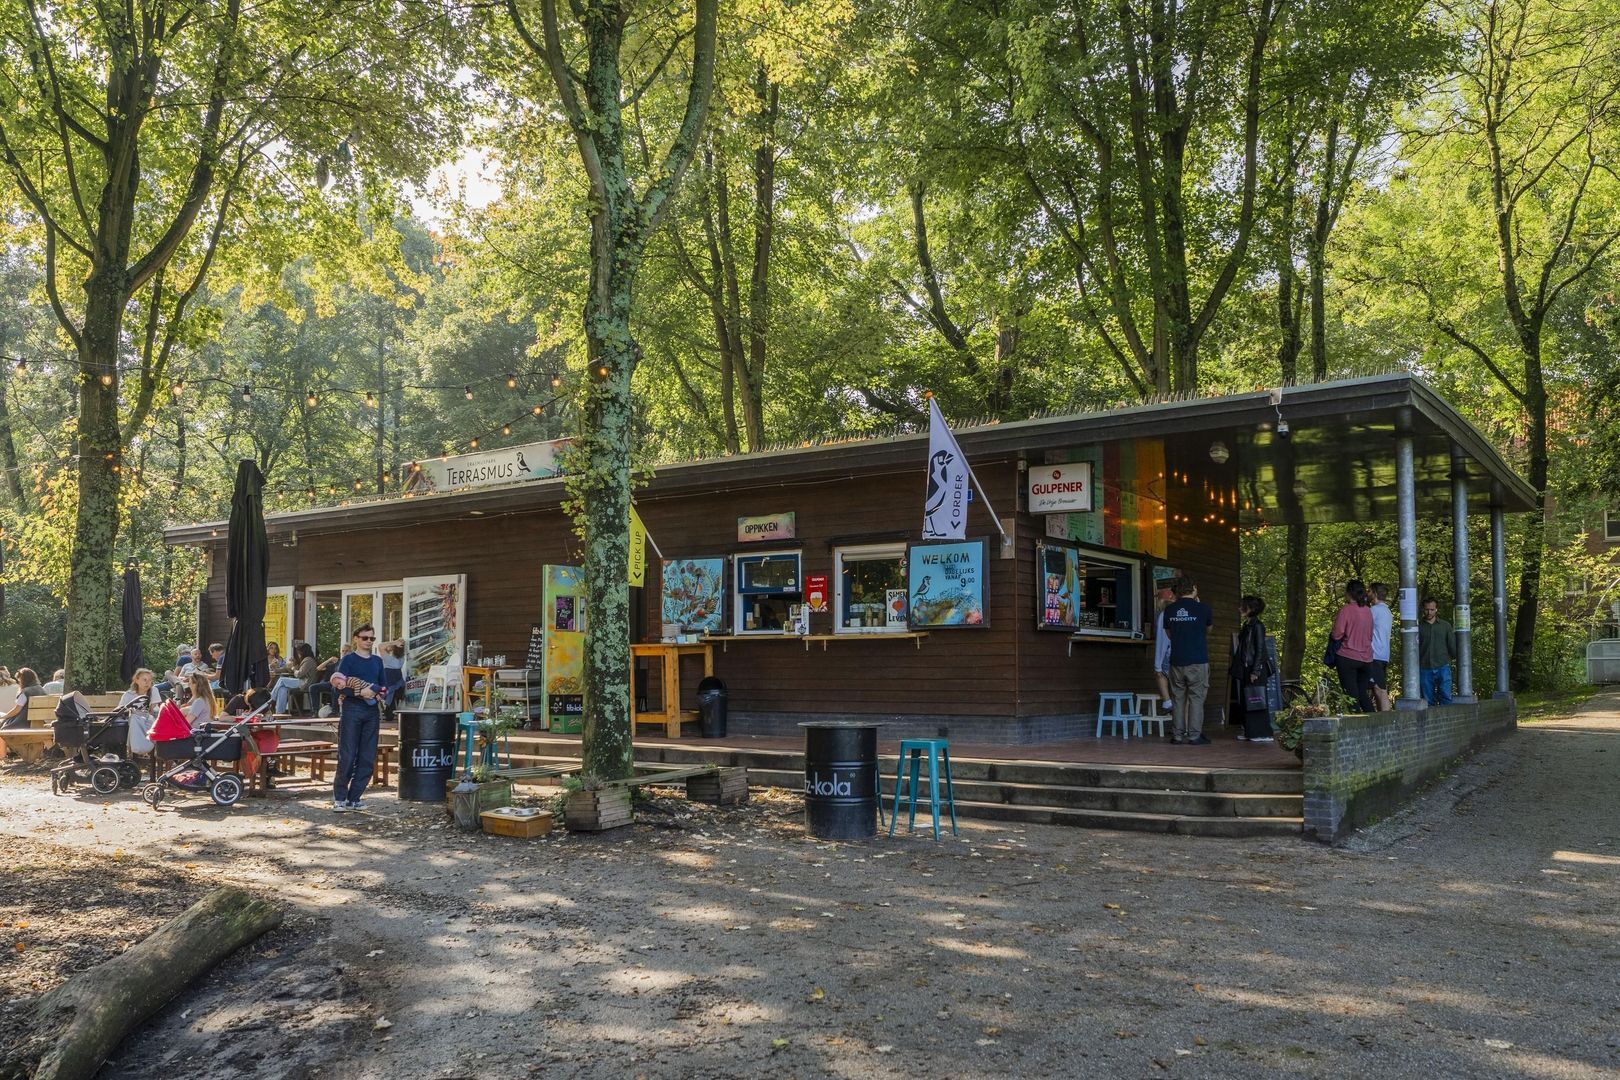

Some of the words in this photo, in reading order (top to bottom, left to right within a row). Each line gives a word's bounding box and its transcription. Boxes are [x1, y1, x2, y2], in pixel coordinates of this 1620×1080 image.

[446, 463, 513, 486] TERRASMUS
[952, 474, 964, 518] ORDER
[1031, 481, 1083, 496] GULPENER
[744, 522, 778, 534] OPPIKKEN
[636, 531, 642, 545] UP
[634, 548, 642, 571] PICK
[922, 552, 970, 566] WELKOM
[805, 771, 851, 796] z-kola
